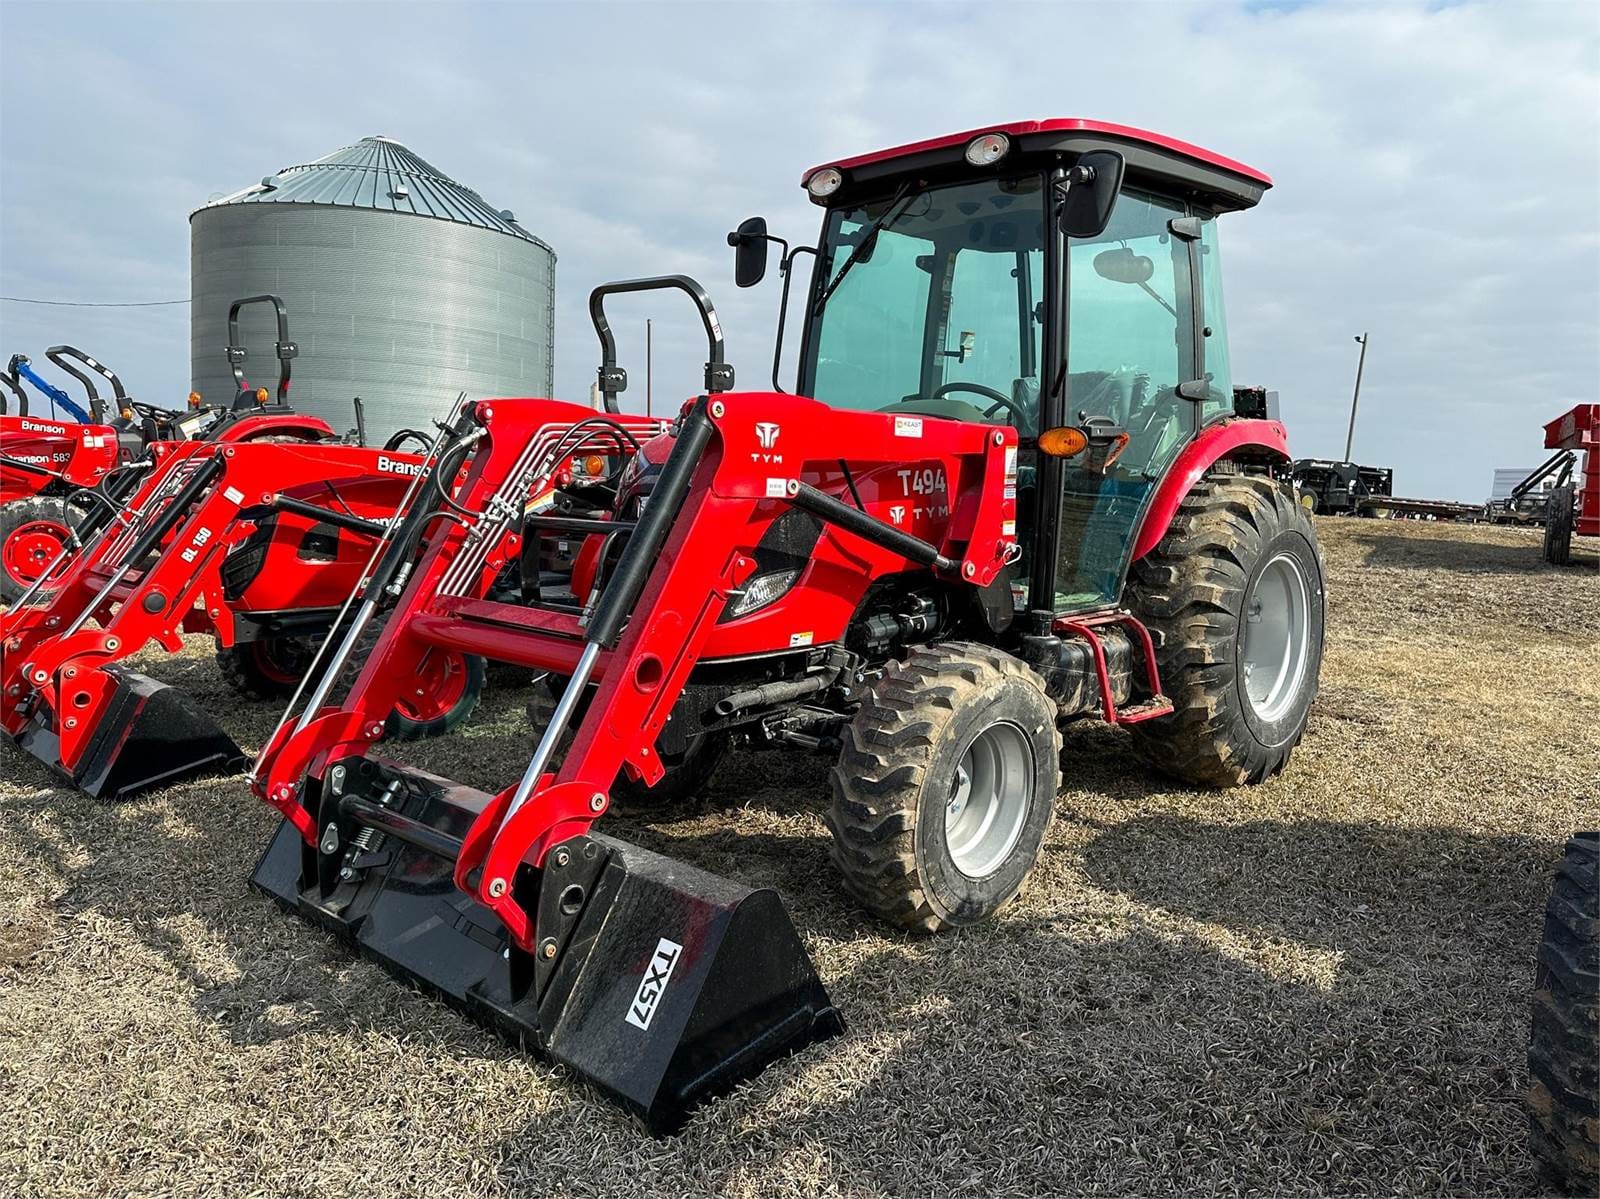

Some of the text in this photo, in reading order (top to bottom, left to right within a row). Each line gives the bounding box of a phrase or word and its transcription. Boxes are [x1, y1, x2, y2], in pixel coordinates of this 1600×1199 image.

[22, 420, 65, 435] Branson
[751, 453, 783, 464] TYM
[897, 468, 946, 496] T494
[913, 505, 949, 520] TYM
[181, 526, 212, 563] BL 150
[632, 948, 678, 1025] TX57
